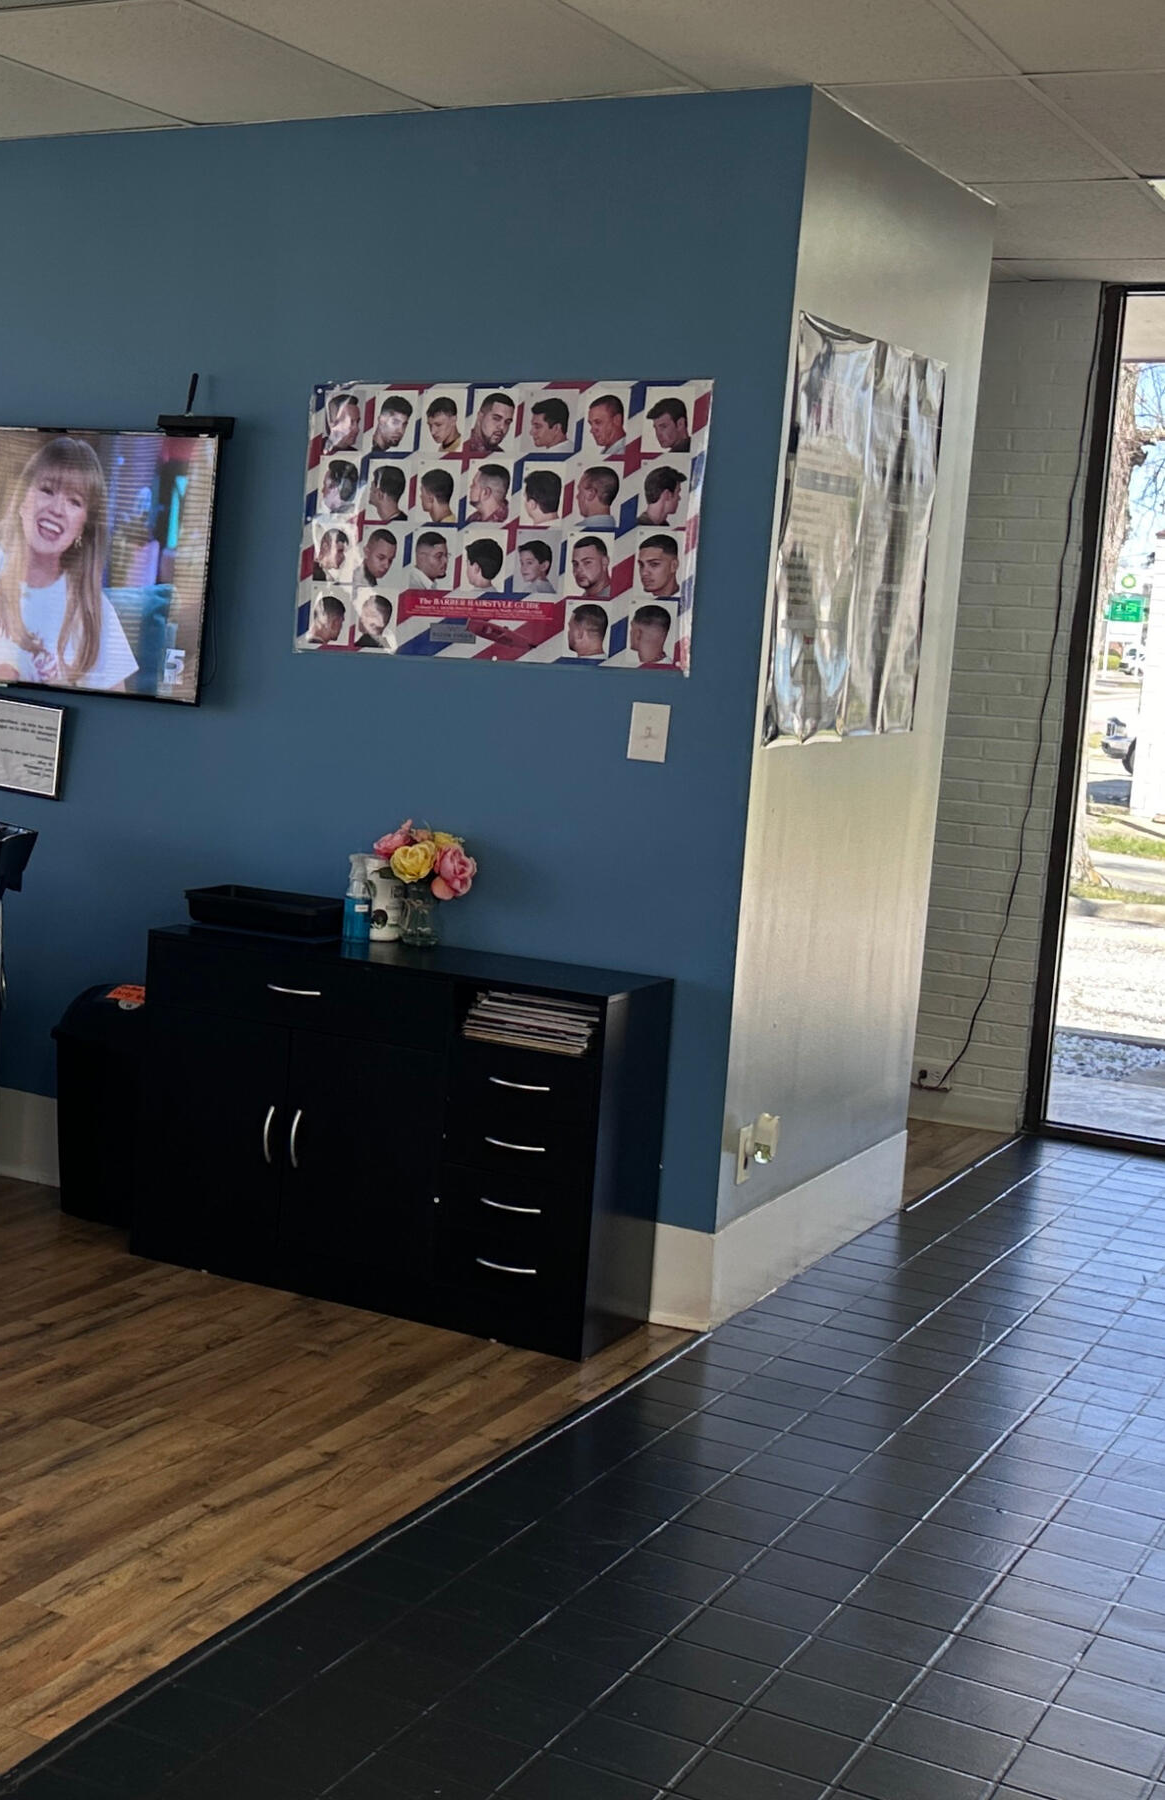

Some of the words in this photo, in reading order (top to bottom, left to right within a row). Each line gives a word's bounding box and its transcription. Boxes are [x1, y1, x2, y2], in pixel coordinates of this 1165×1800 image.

[419, 597, 432, 605] The
[433, 598, 466, 607] BARBER
[467, 599, 512, 609] HAIRSTYLE
[514, 602, 540, 610] GUIDE
[165, 648, 186, 674] 5
